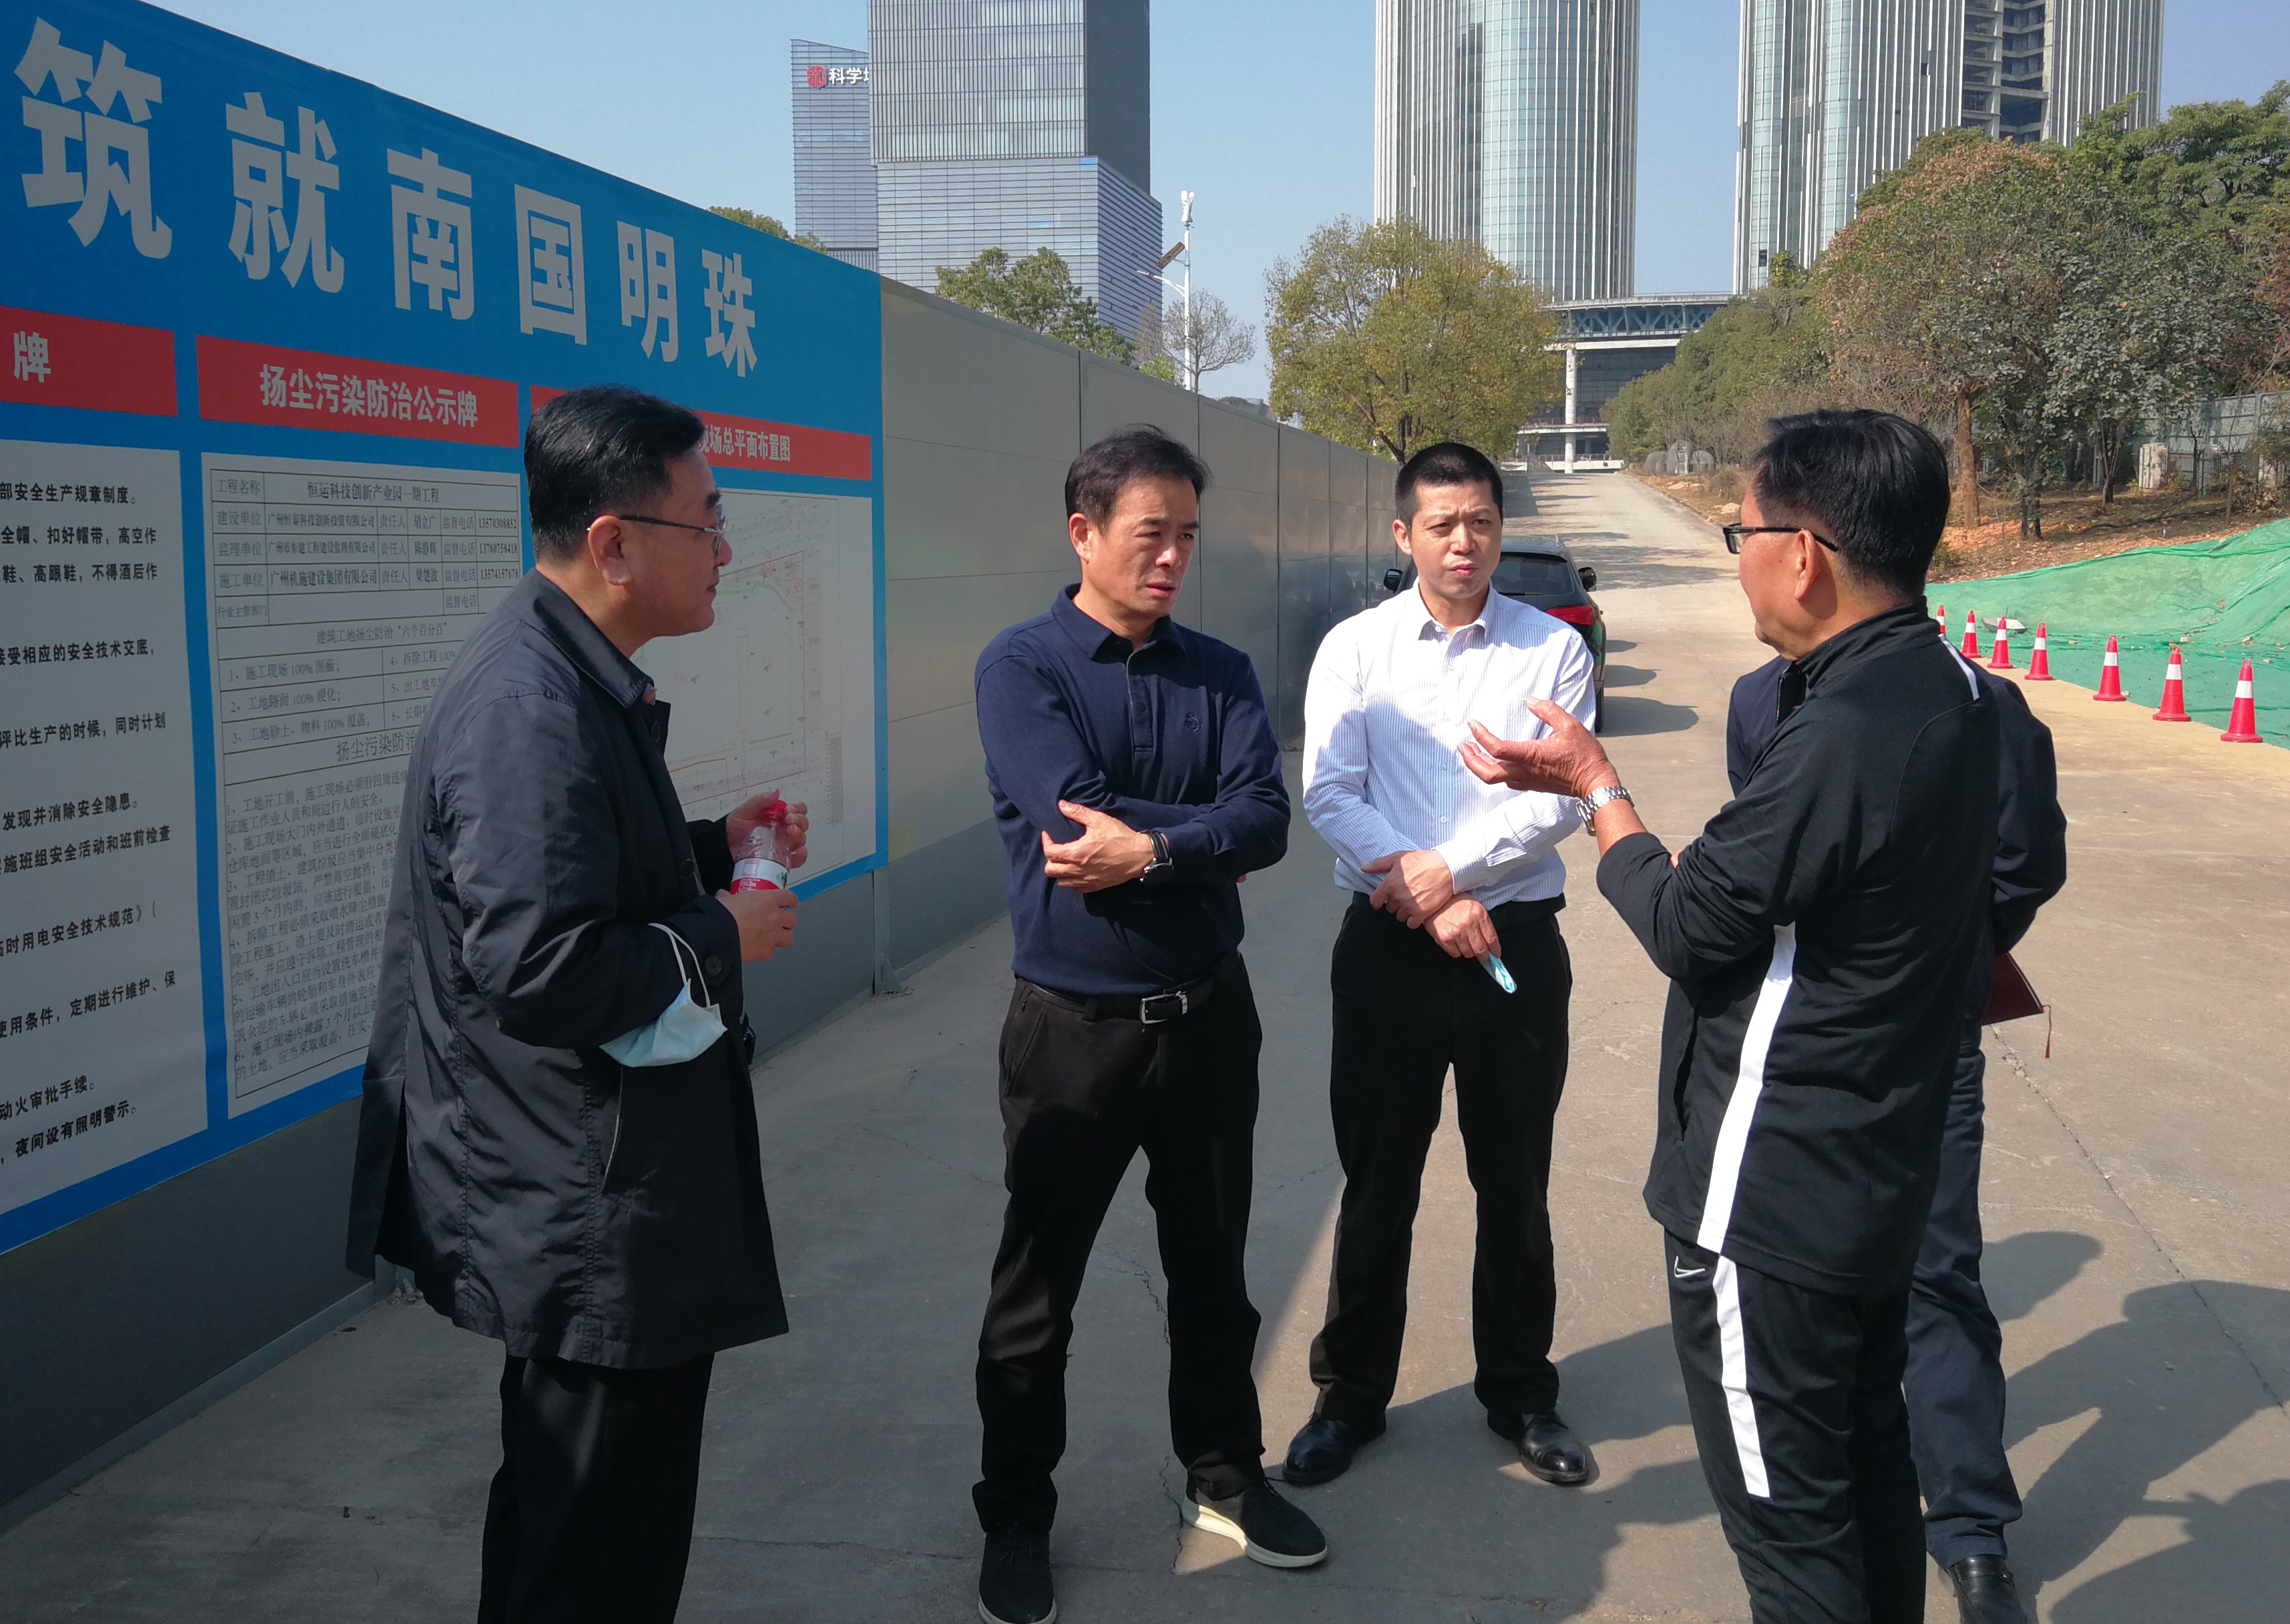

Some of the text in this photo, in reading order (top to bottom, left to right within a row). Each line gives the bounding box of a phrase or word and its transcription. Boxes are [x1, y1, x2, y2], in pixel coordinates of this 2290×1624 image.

[829, 66, 869, 84] 科学
[15, 16, 759, 378] 筑就南国明珠
[13, 331, 52, 385] 牌
[259, 363, 478, 429] 扬尘污染防治公示牌
[0, 481, 136, 504] 部安全生产规章制度。
[217, 478, 261, 495] 工程名称
[217, 510, 261, 526] 建设单位
[380, 514, 406, 529] 责任人
[443, 516, 474, 530] 监督电话
[218, 541, 262, 556] 监理单位
[381, 542, 407, 556] 责任人
[443, 542, 475, 556] 监督电话
[219, 572, 263, 588] 施工单位
[381, 569, 408, 584] 责任人
[444, 568, 476, 582] 监督电话
[445, 594, 477, 608] 监督电话
[391, 676, 442, 694] 5、出工地车
[3, 793, 138, 831] 发现并消除安全隐患。
[0, 825, 170, 875] 施班组安全活动和班前检查
[0, 1075, 94, 1121] 动火审批手续。
